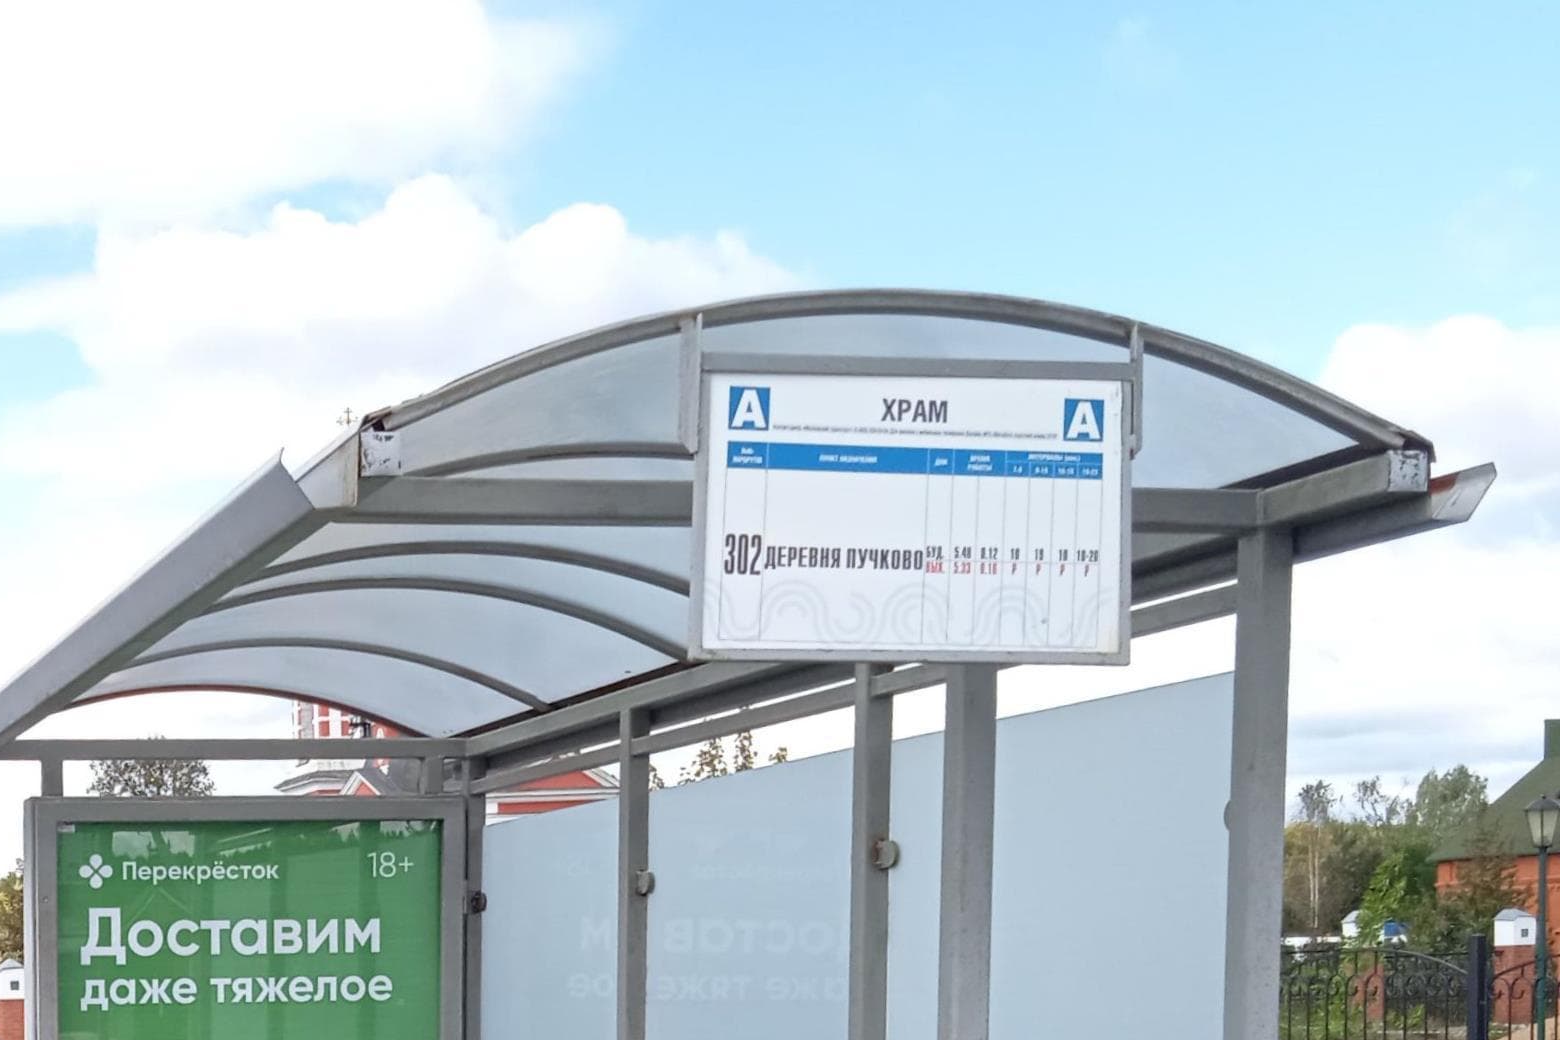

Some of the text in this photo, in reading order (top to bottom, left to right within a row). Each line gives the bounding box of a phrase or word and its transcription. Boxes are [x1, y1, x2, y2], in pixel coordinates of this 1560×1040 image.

[731, 388, 767, 430] А
[881, 398, 948, 424] ХРАМ
[1065, 400, 1102, 441] А
[724, 533, 924, 576] 302 ДЕРЕВНЯ ПУЧКОВО
[122, 860, 279, 884] Перекрёсток
[367, 852, 415, 879] 18+
[80, 906, 381, 966] Доставим
[80, 975, 393, 1011] даже тяжелое
